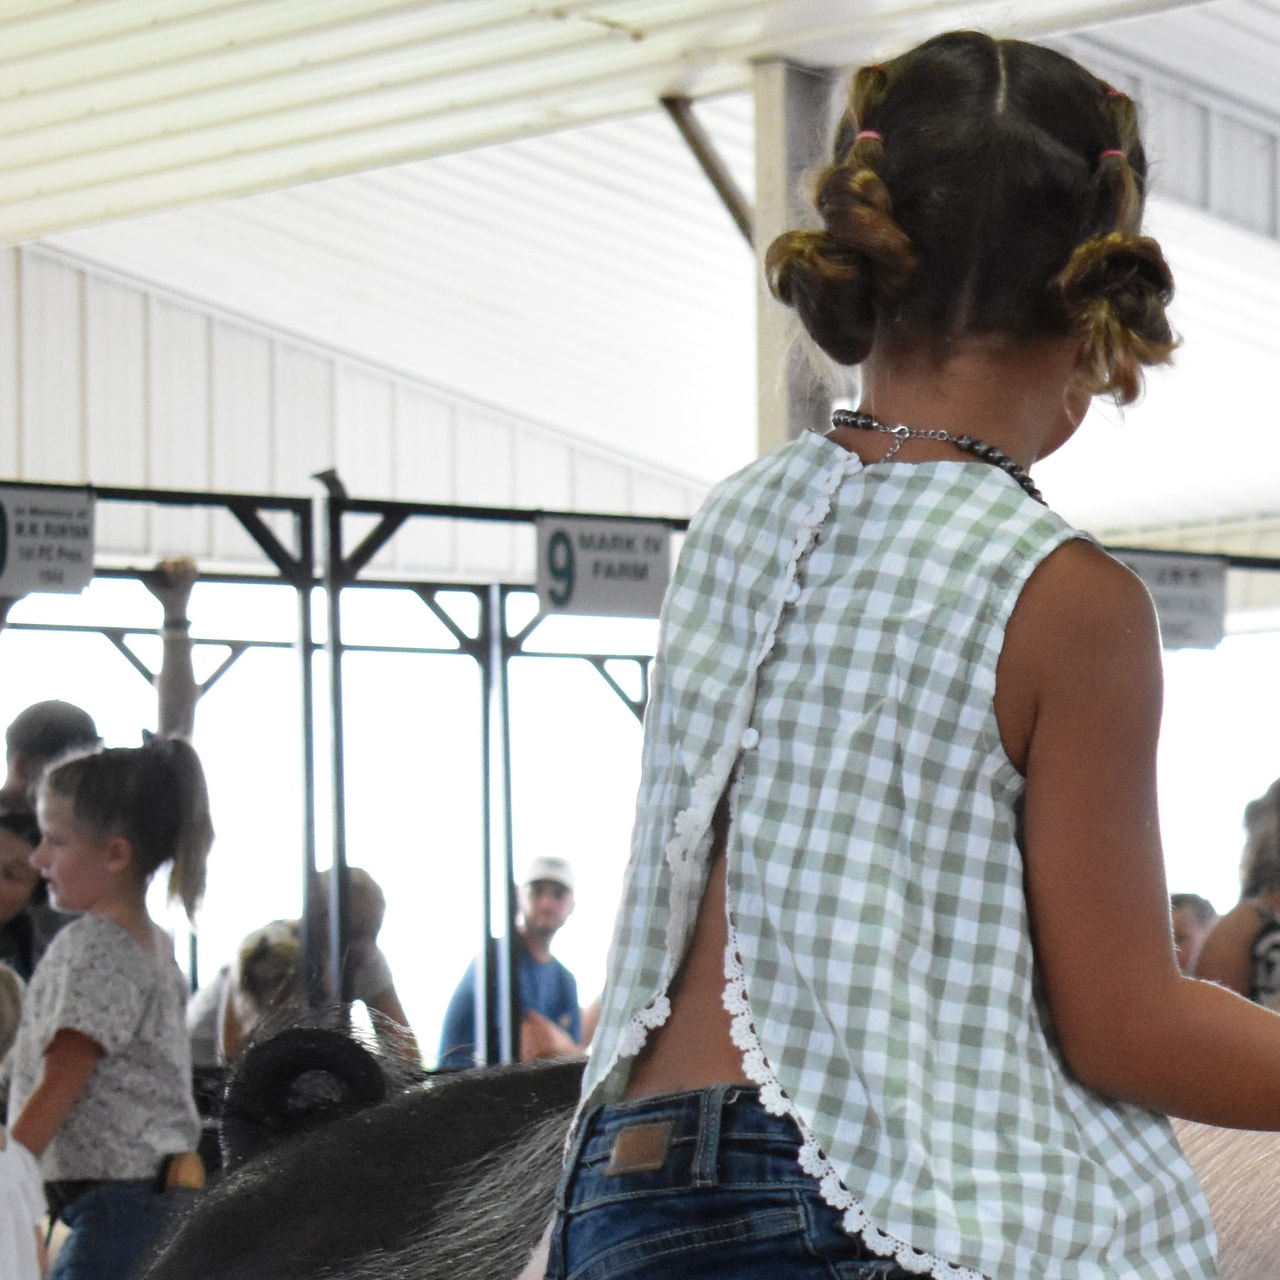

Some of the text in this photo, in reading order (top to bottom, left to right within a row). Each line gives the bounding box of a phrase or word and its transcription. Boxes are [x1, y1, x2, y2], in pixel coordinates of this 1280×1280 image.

[578, 533, 636, 553] MARK
[547, 527, 575, 609] 9
[591, 561, 649, 582] FARM
